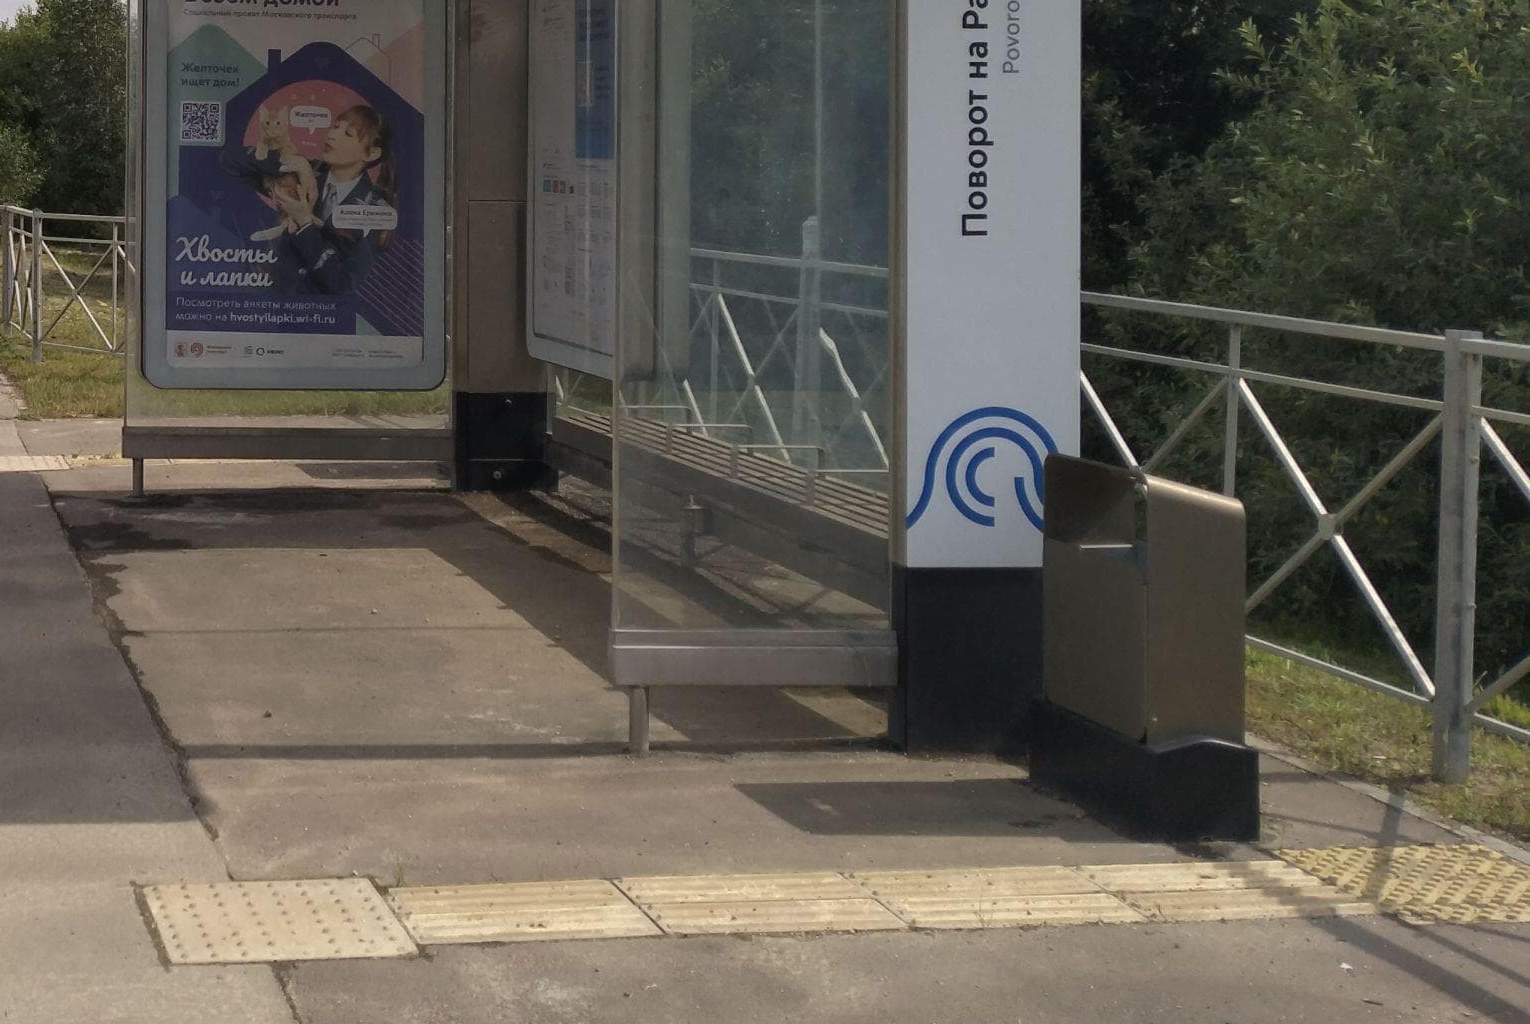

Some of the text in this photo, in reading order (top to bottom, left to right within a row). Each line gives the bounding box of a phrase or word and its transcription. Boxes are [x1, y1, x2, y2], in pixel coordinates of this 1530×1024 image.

[969, 40, 988, 79] на
[212, 78, 240, 88] дом!
[962, 89, 994, 236] Поворот
[175, 234, 278, 264] Хвосты
[180, 271, 274, 287] и лапки
[176, 296, 241, 310] Посмотреть
[283, 301, 336, 312] животных
[175, 312, 213, 322] можно
